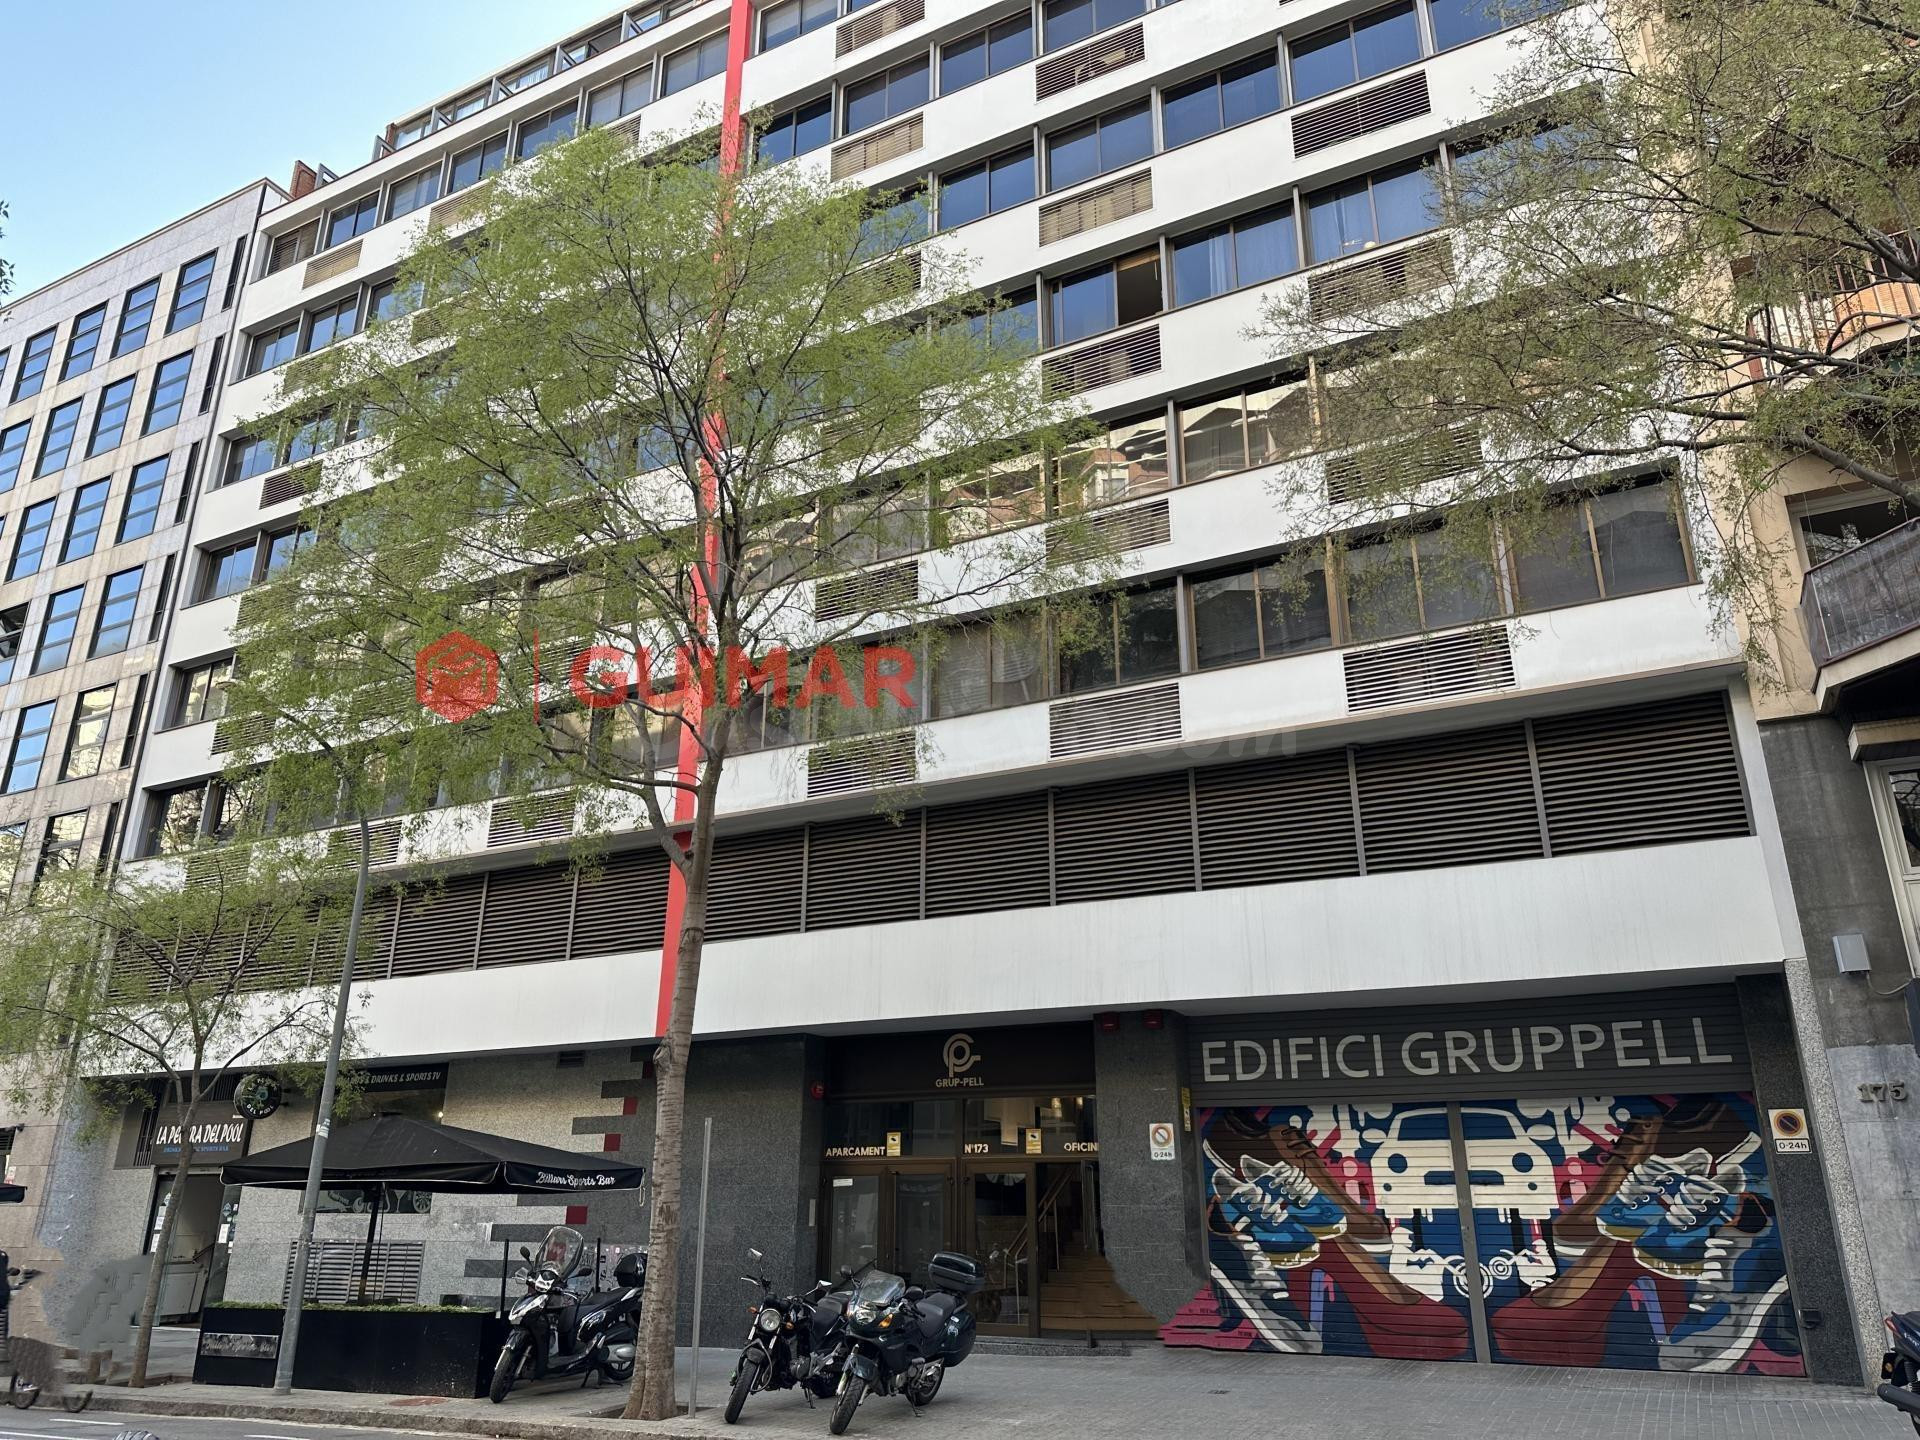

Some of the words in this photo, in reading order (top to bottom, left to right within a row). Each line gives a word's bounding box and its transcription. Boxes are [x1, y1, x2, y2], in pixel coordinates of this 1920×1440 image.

[1201, 1033, 1384, 1084] EDIFICI
[1400, 1016, 1733, 1076] GRUPPELL
[370, 1073, 398, 1084] DRINKS
[405, 1071, 432, 1082] SPORTS
[935, 1077, 985, 1088] GRUP-PELL
[1855, 1080, 1906, 1102] 175
[156, 1125, 168, 1145] LA
[168, 1124, 202, 1144] PERA
[203, 1123, 221, 1144] DEL
[220, 1122, 244, 1143] POOL
[826, 1146, 886, 1157] APARCAMENT
[566, 1173, 596, 1188] Sports
[596, 1174, 616, 1185] Bar
